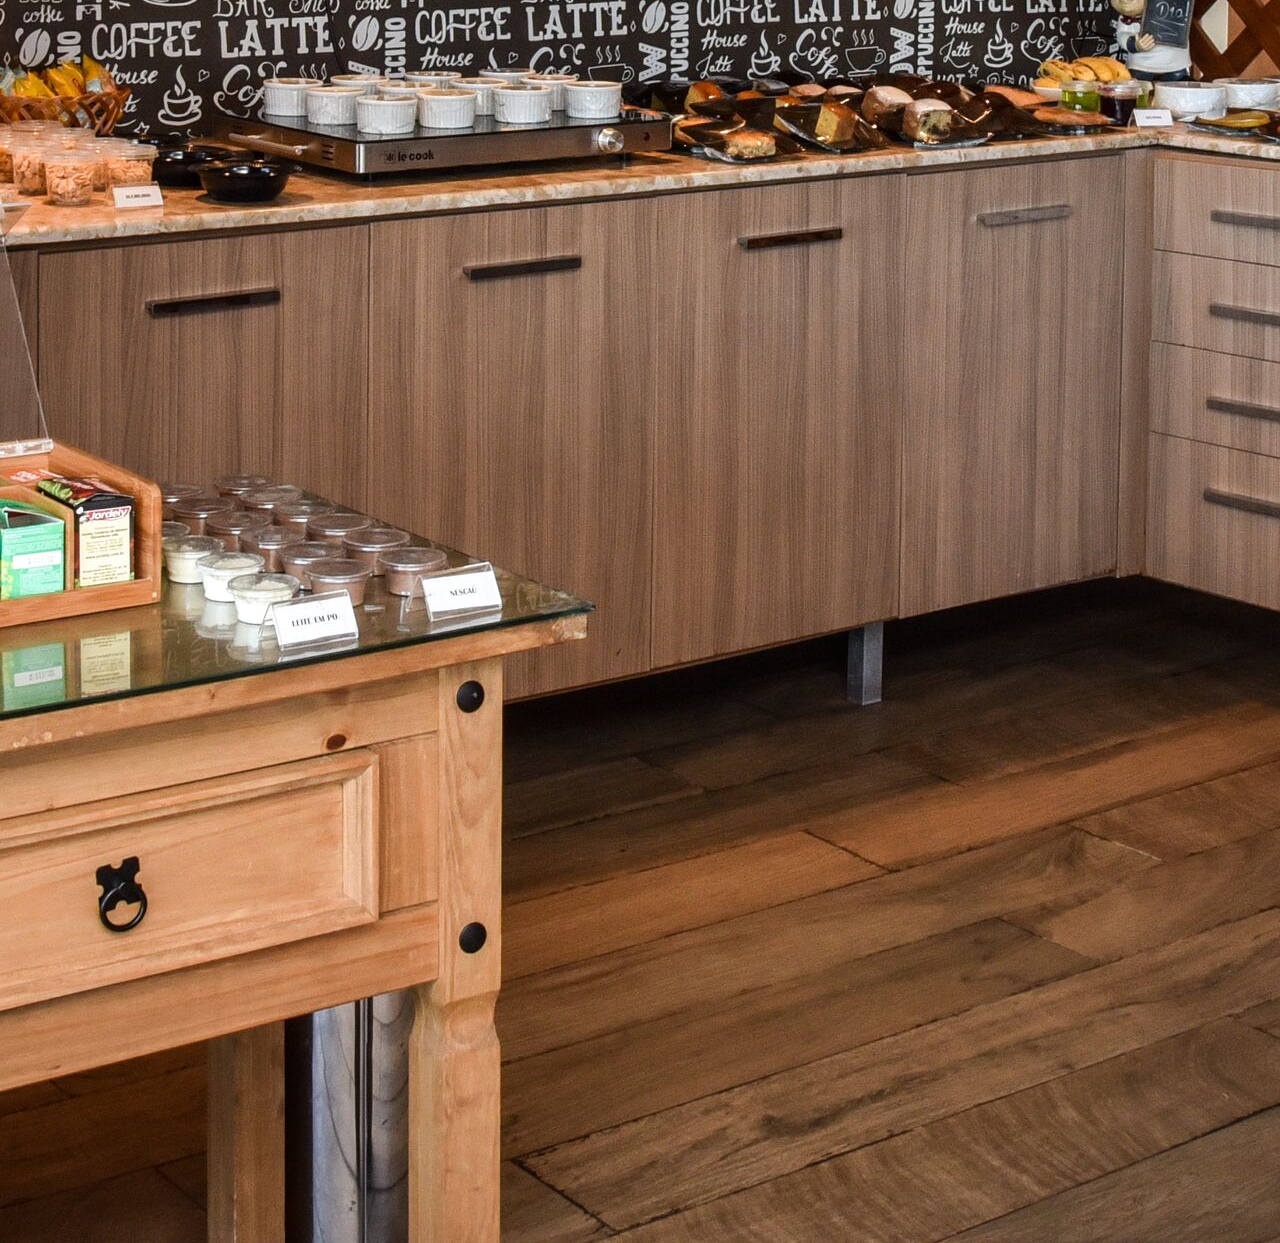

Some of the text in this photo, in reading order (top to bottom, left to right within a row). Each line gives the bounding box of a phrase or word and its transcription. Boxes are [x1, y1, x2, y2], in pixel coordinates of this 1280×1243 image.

[219, 13, 334, 58] LATTE
[945, 20, 985, 37] House
[701, 32, 748, 49] House
[409, 149, 434, 160] cook
[291, 619, 312, 627] LEITE
[314, 616, 325, 625] EM
